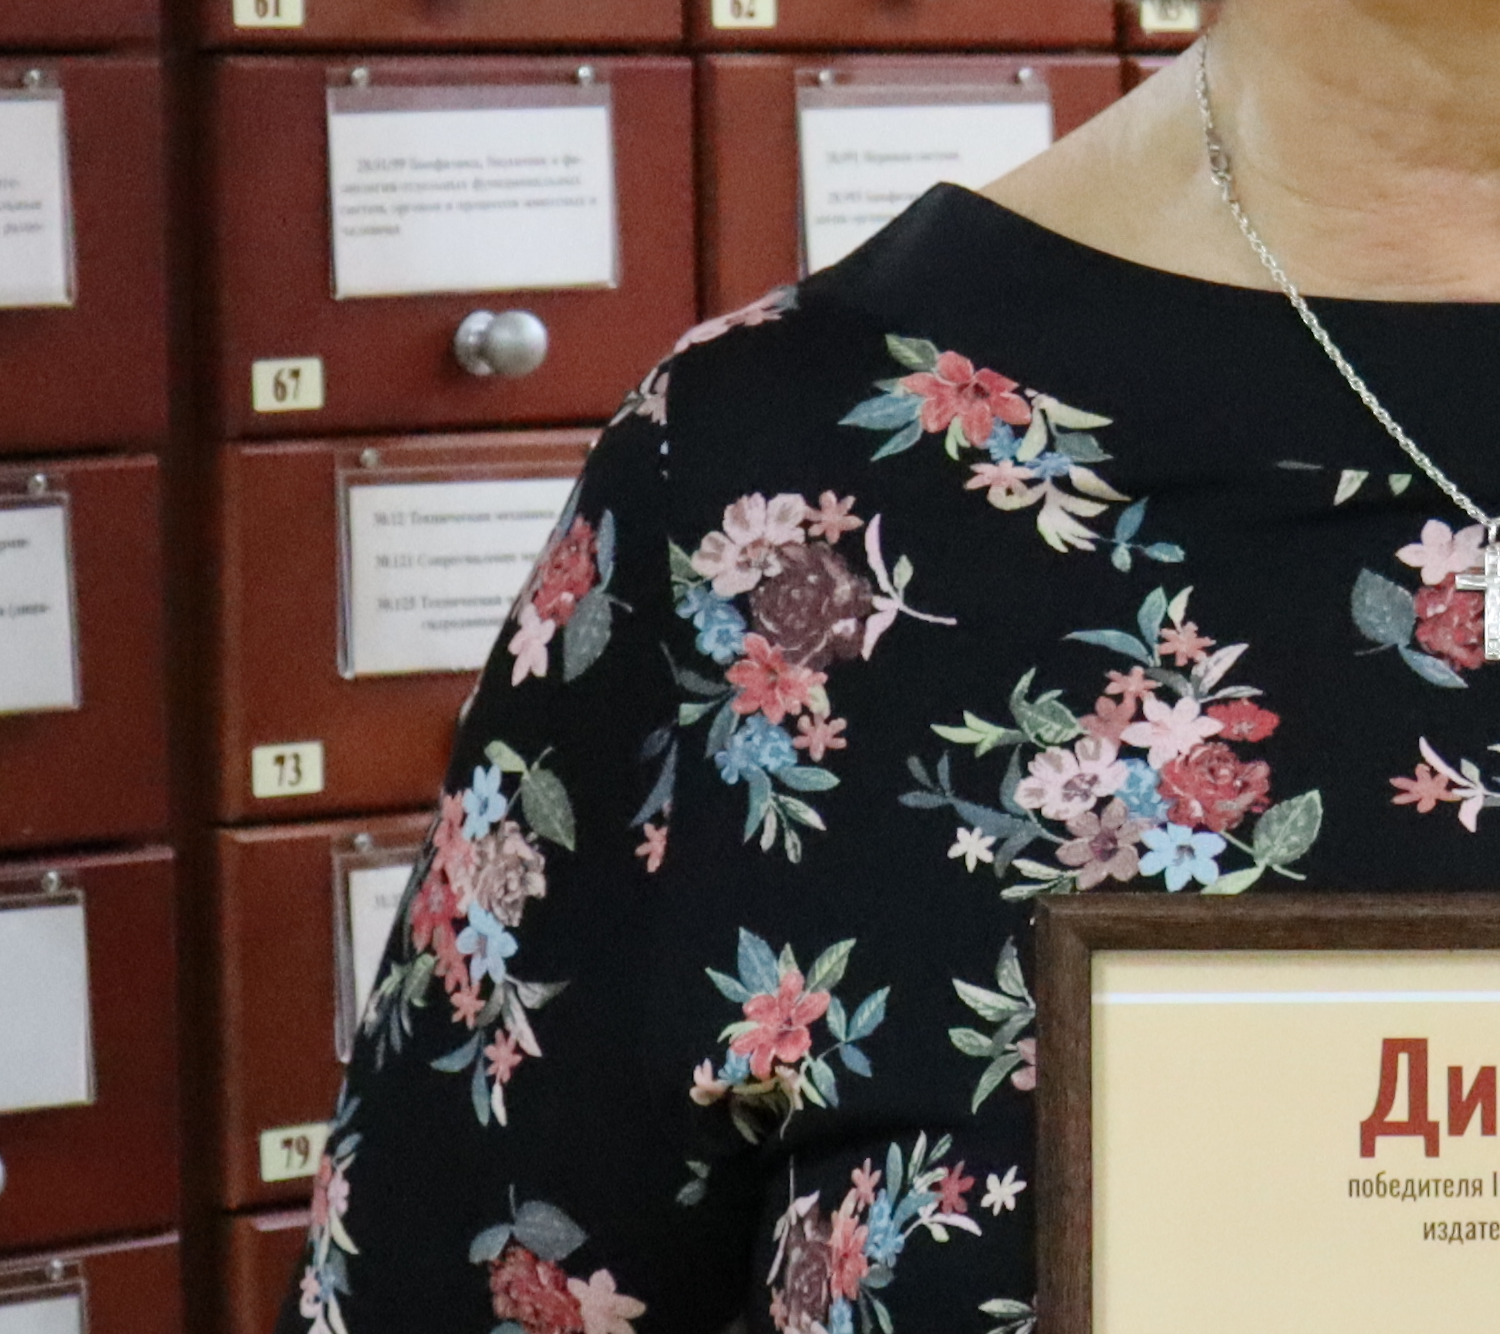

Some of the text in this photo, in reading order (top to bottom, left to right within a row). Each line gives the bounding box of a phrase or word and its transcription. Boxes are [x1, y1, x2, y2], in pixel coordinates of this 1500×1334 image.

[272, 367, 302, 403] 67
[273, 752, 303, 787] 73
[280, 1134, 311, 1167] 79
[1347, 1170, 1484, 1202] победителя
